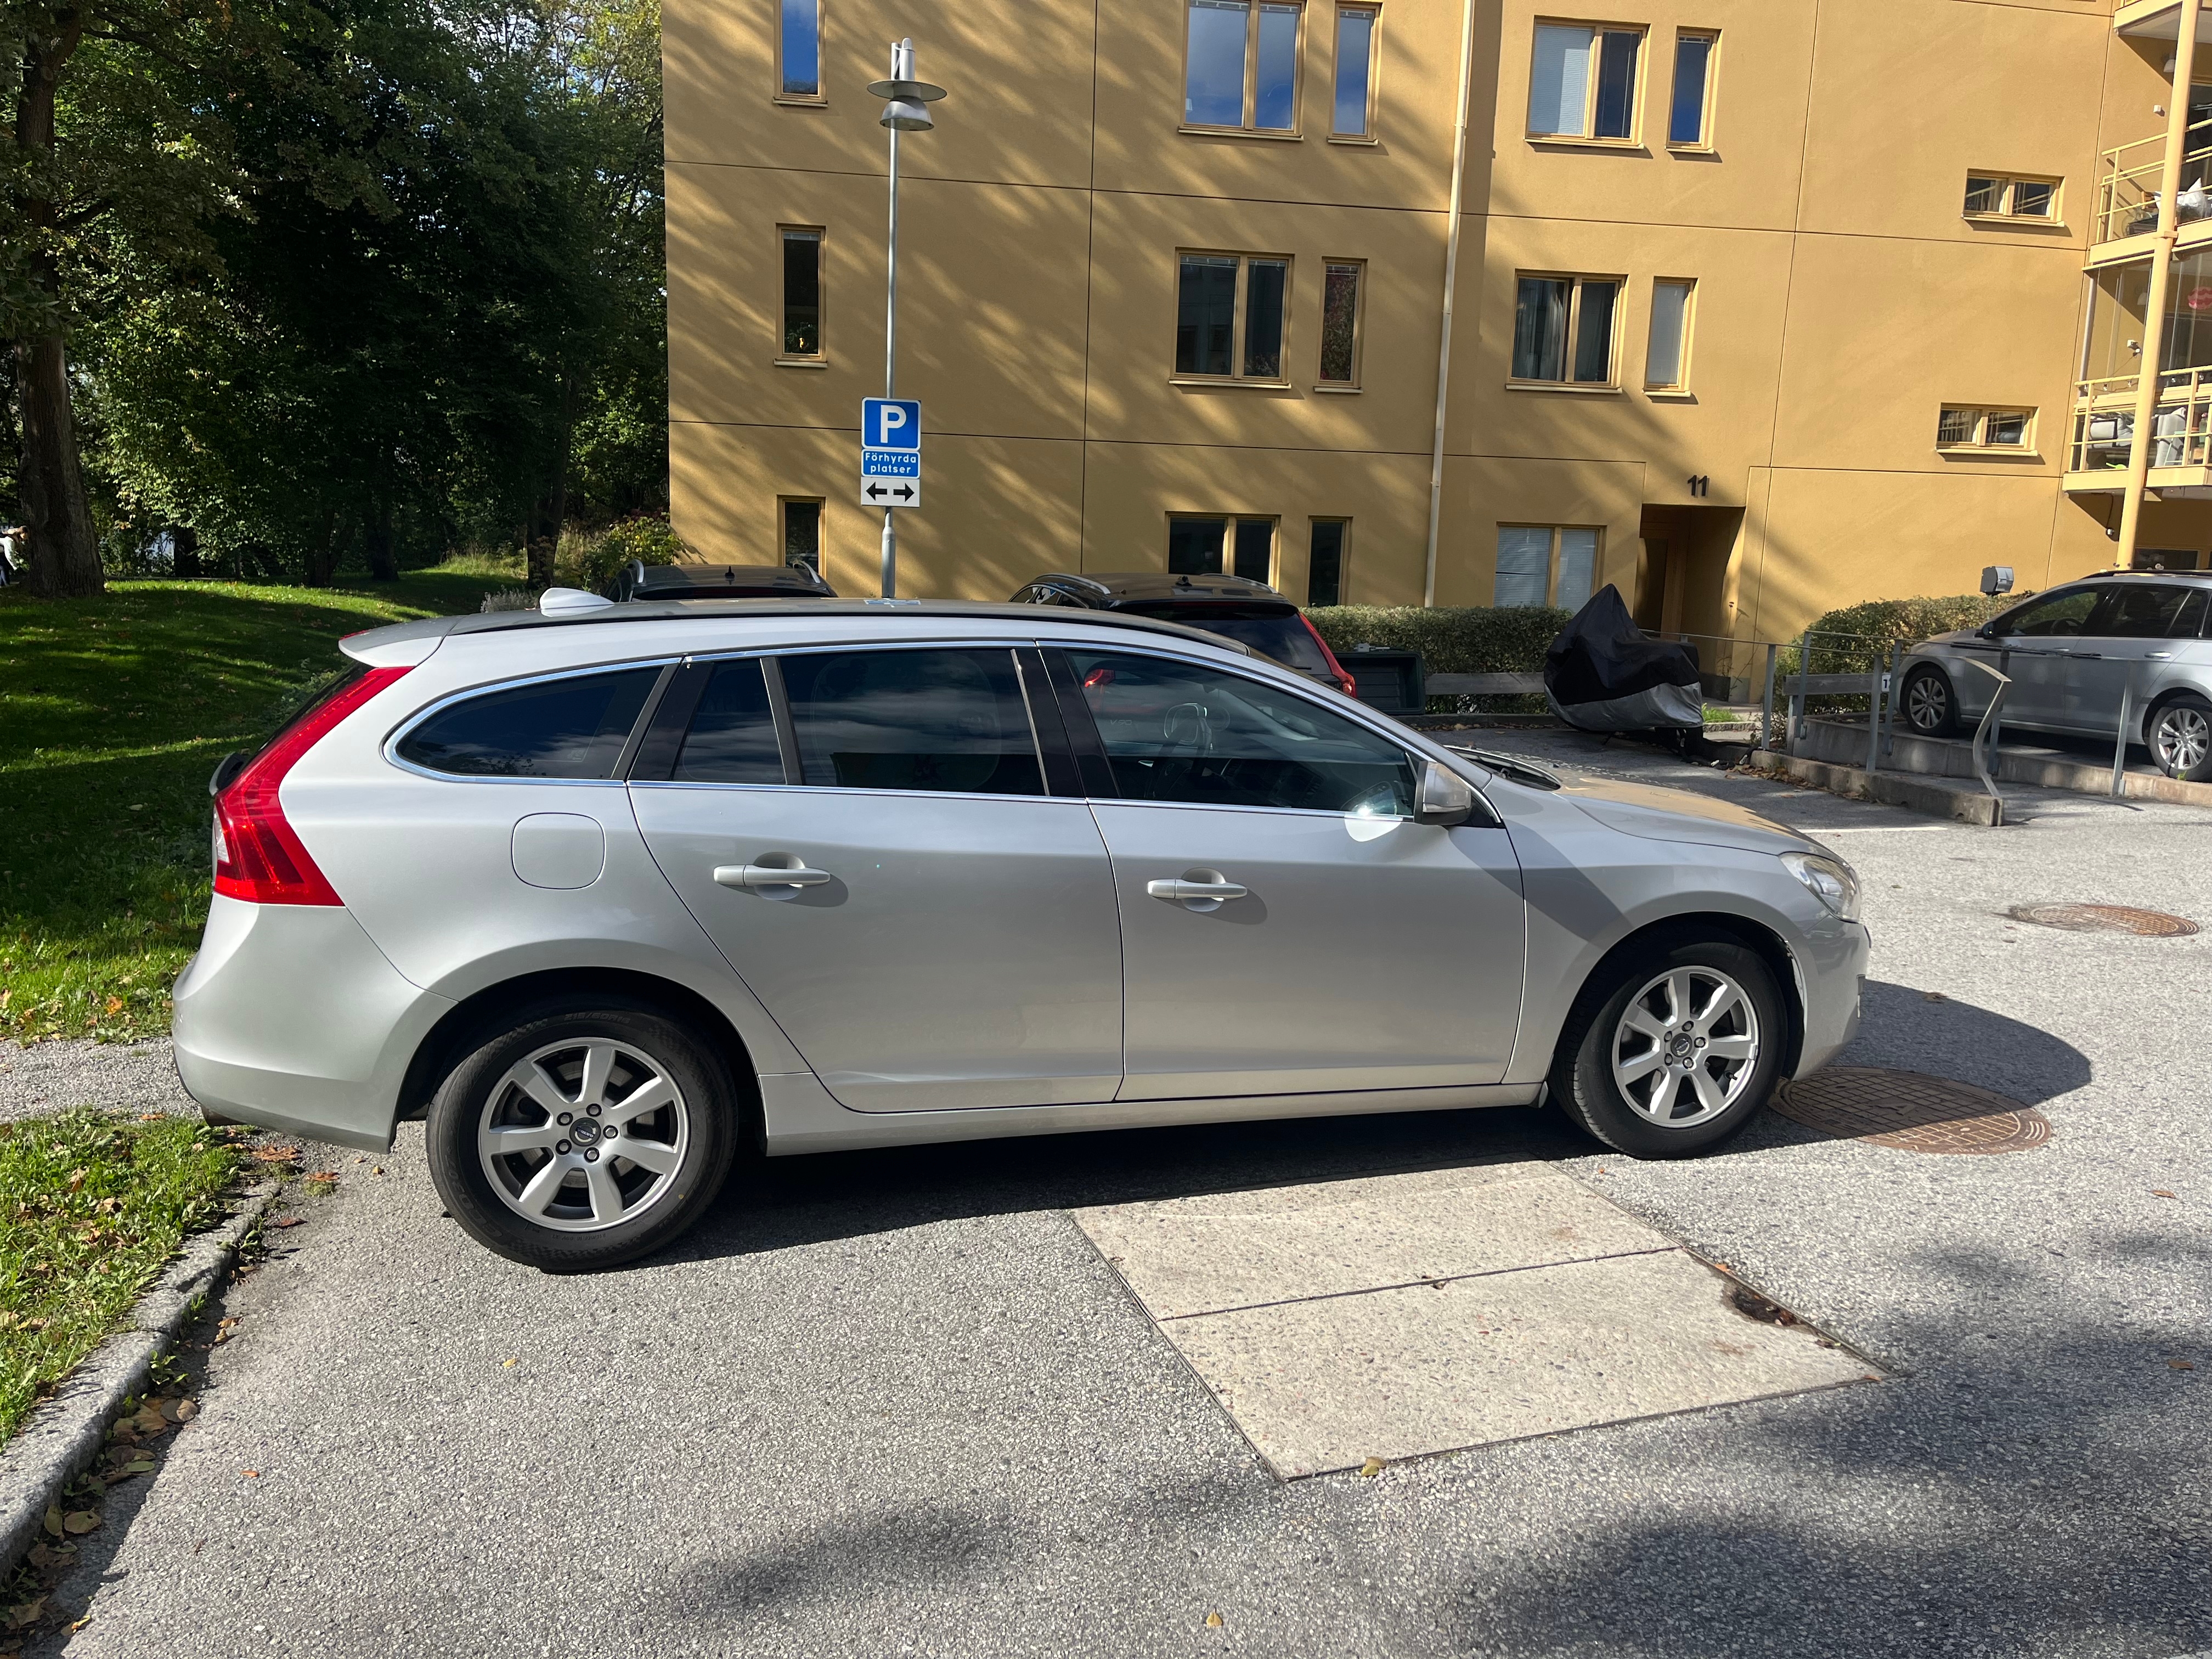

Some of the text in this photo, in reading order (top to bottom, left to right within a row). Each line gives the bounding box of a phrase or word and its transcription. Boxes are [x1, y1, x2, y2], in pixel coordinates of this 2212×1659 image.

[880, 404, 907, 444] P
[865, 452, 917, 464] Förhyrda
[870, 464, 911, 474] platser
[1687, 475, 1707, 496] 11
[577, 1127, 594, 1138] VOLVO
